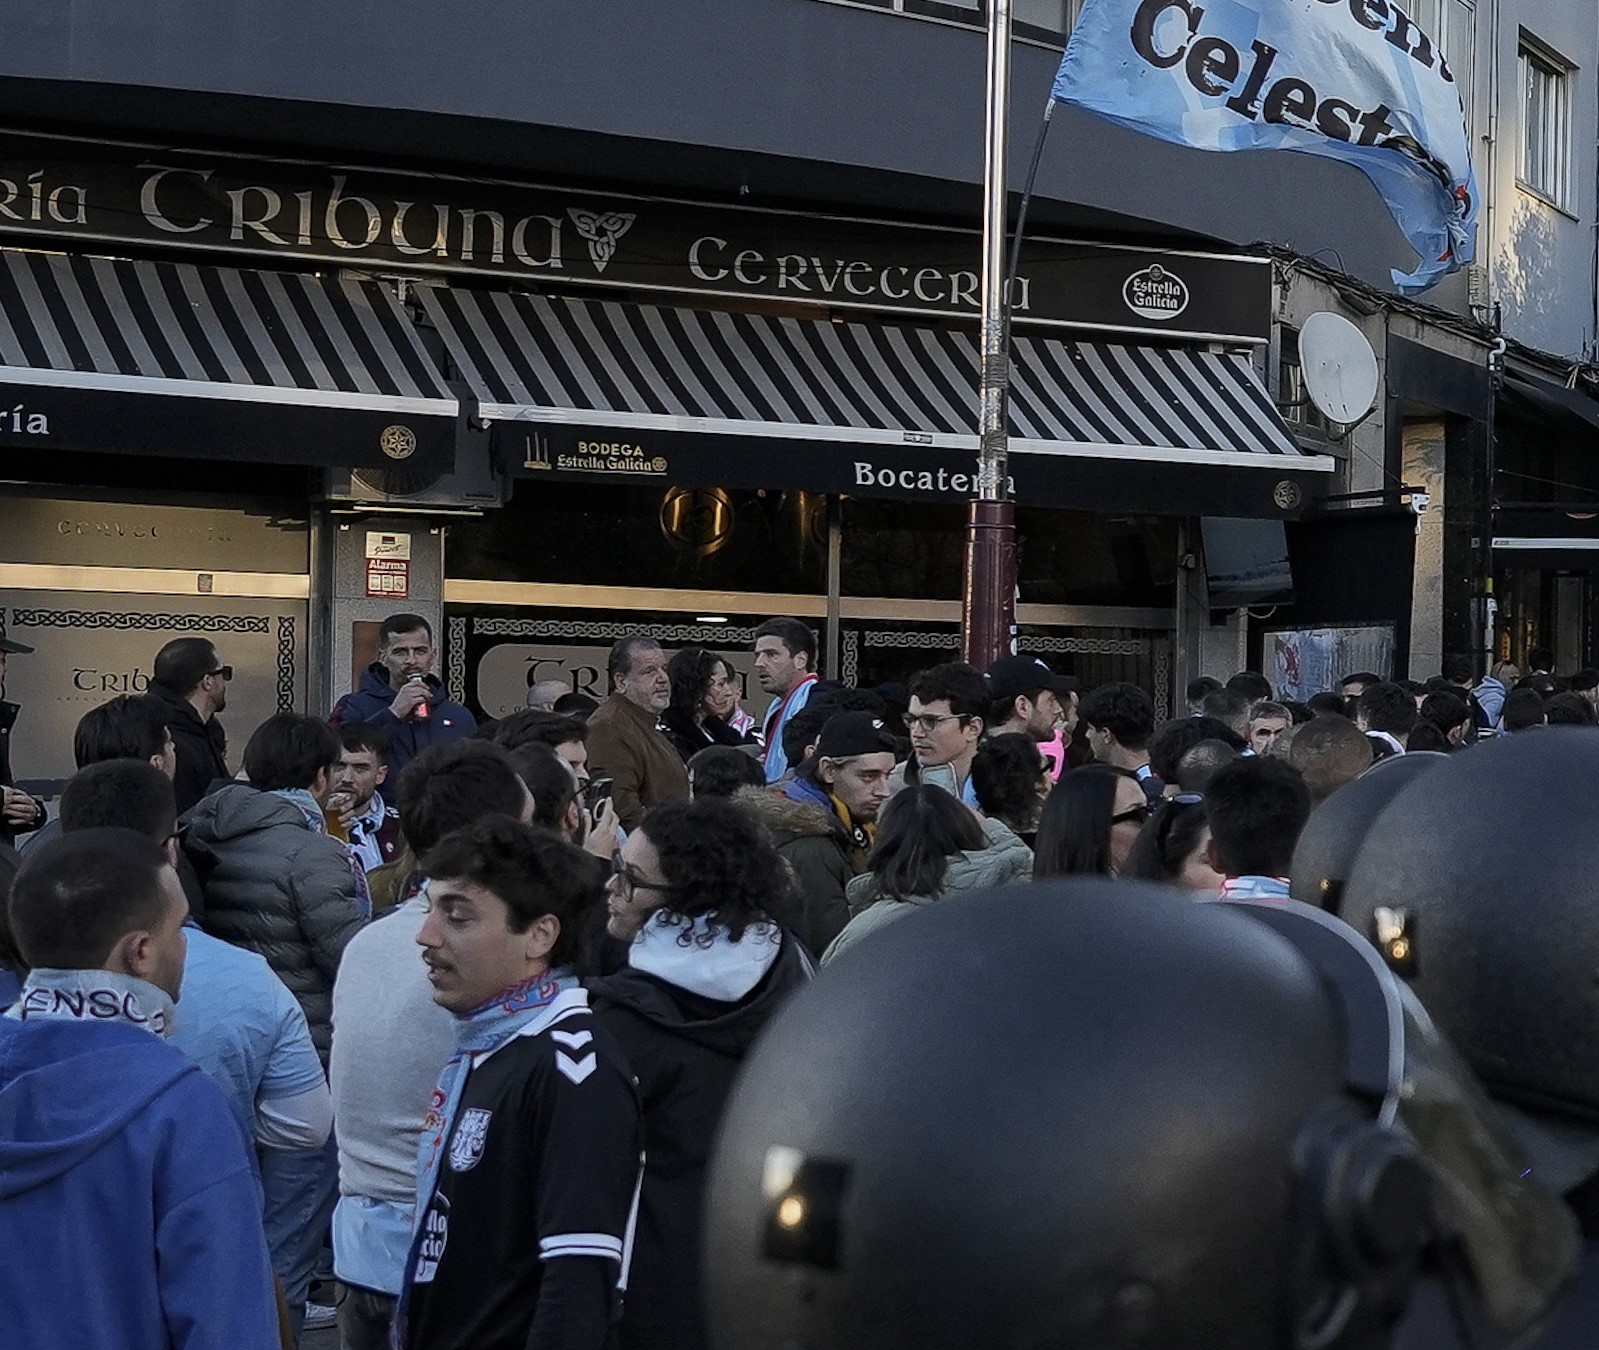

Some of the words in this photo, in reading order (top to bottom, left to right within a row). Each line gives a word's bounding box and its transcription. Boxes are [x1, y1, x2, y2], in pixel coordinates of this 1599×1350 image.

[689, 236, 1031, 310] Cervecera
[1132, 278, 1181, 296] Estrella
[1133, 292, 1178, 309] Galicia
[578, 441, 644, 457] BODEGA
[557, 454, 605, 470] Estrella
[606, 456, 652, 472] Galicia
[853, 461, 1016, 494] Bocatera
[369, 559, 407, 570] Alarma
[72, 668, 150, 692] Trib
